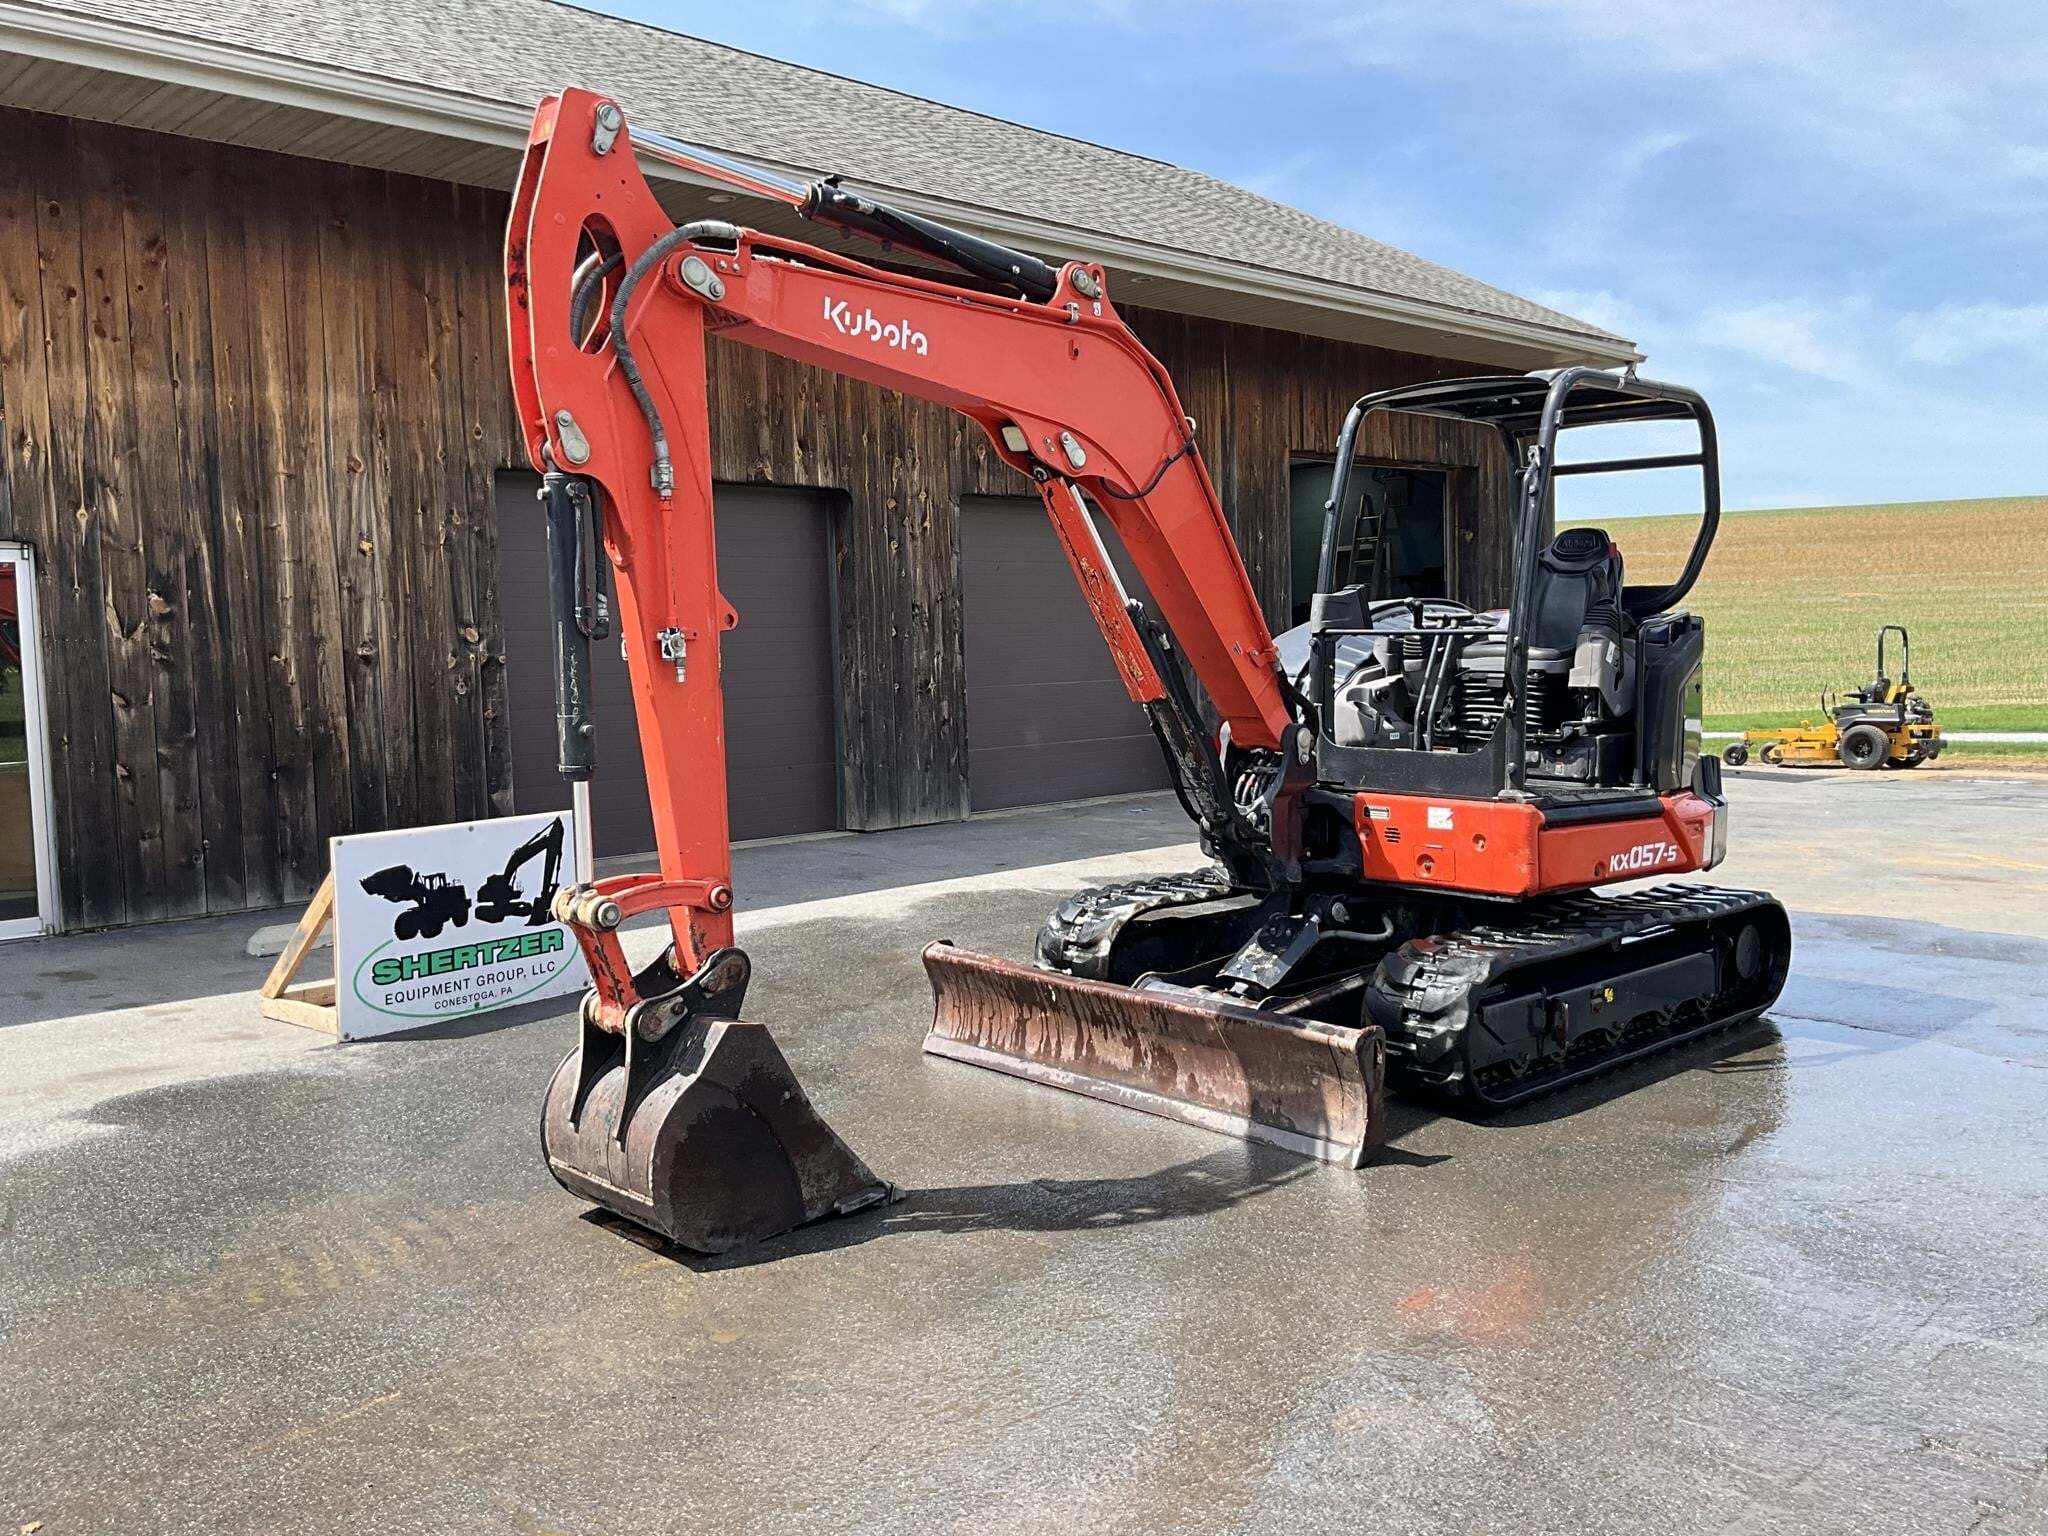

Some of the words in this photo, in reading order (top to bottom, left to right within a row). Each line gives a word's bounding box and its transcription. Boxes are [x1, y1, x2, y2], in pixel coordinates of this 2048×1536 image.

[823, 295, 928, 356] Kubota
[1609, 842, 1677, 872] KX057-5
[372, 928, 564, 986] SHERTZER
[385, 978, 470, 1006] EQUIPMENT
[476, 968, 527, 987] GROUP,
[532, 961, 556, 976] LLC
[434, 989, 498, 1010] CONESTOGA,
[501, 986, 513, 995] PA
